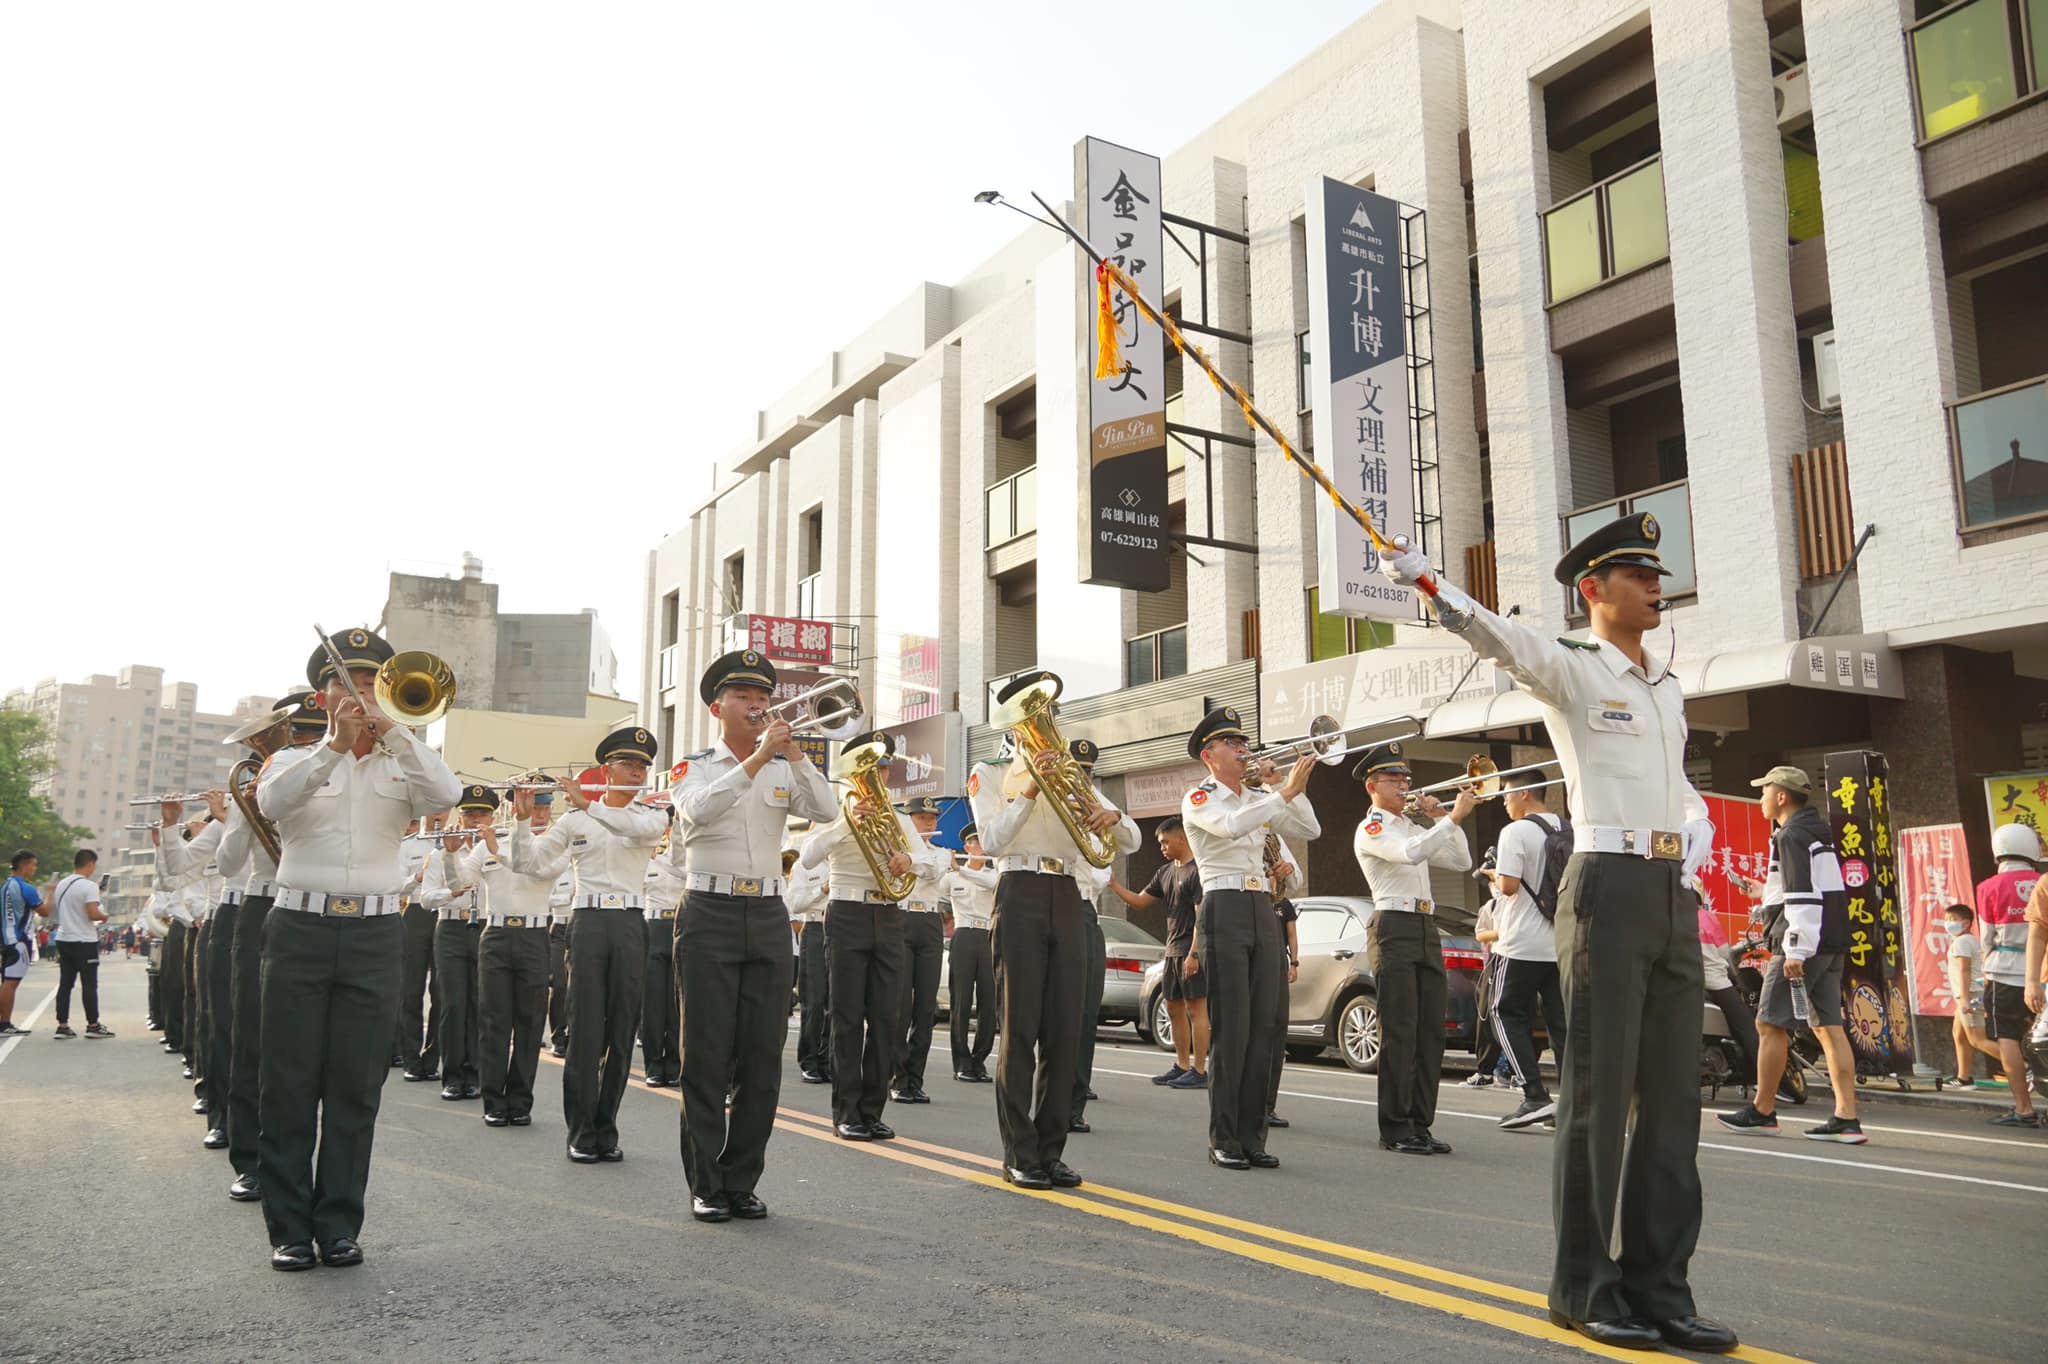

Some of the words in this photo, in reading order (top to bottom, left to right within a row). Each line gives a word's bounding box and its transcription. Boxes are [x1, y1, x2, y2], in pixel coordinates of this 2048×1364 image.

[1342, 227, 1367, 241] LIBERAL
[1367, 235, 1383, 246] ARTS
[1341, 241, 1385, 265] 高雄市私立
[1349, 268, 1384, 358] 升博
[1101, 507, 1160, 528] 高雄岡山校
[1101, 530, 1158, 550] 07-6229123
[1346, 582, 1409, 603] 07-6218387
[770, 621, 827, 650] 檳榔
[1299, 674, 1346, 718] 升博
[1356, 652, 1485, 705] 文理補習班
[1832, 776, 1874, 967] 章魚丸子
[1869, 776, 1899, 967] 章魚小丸子
